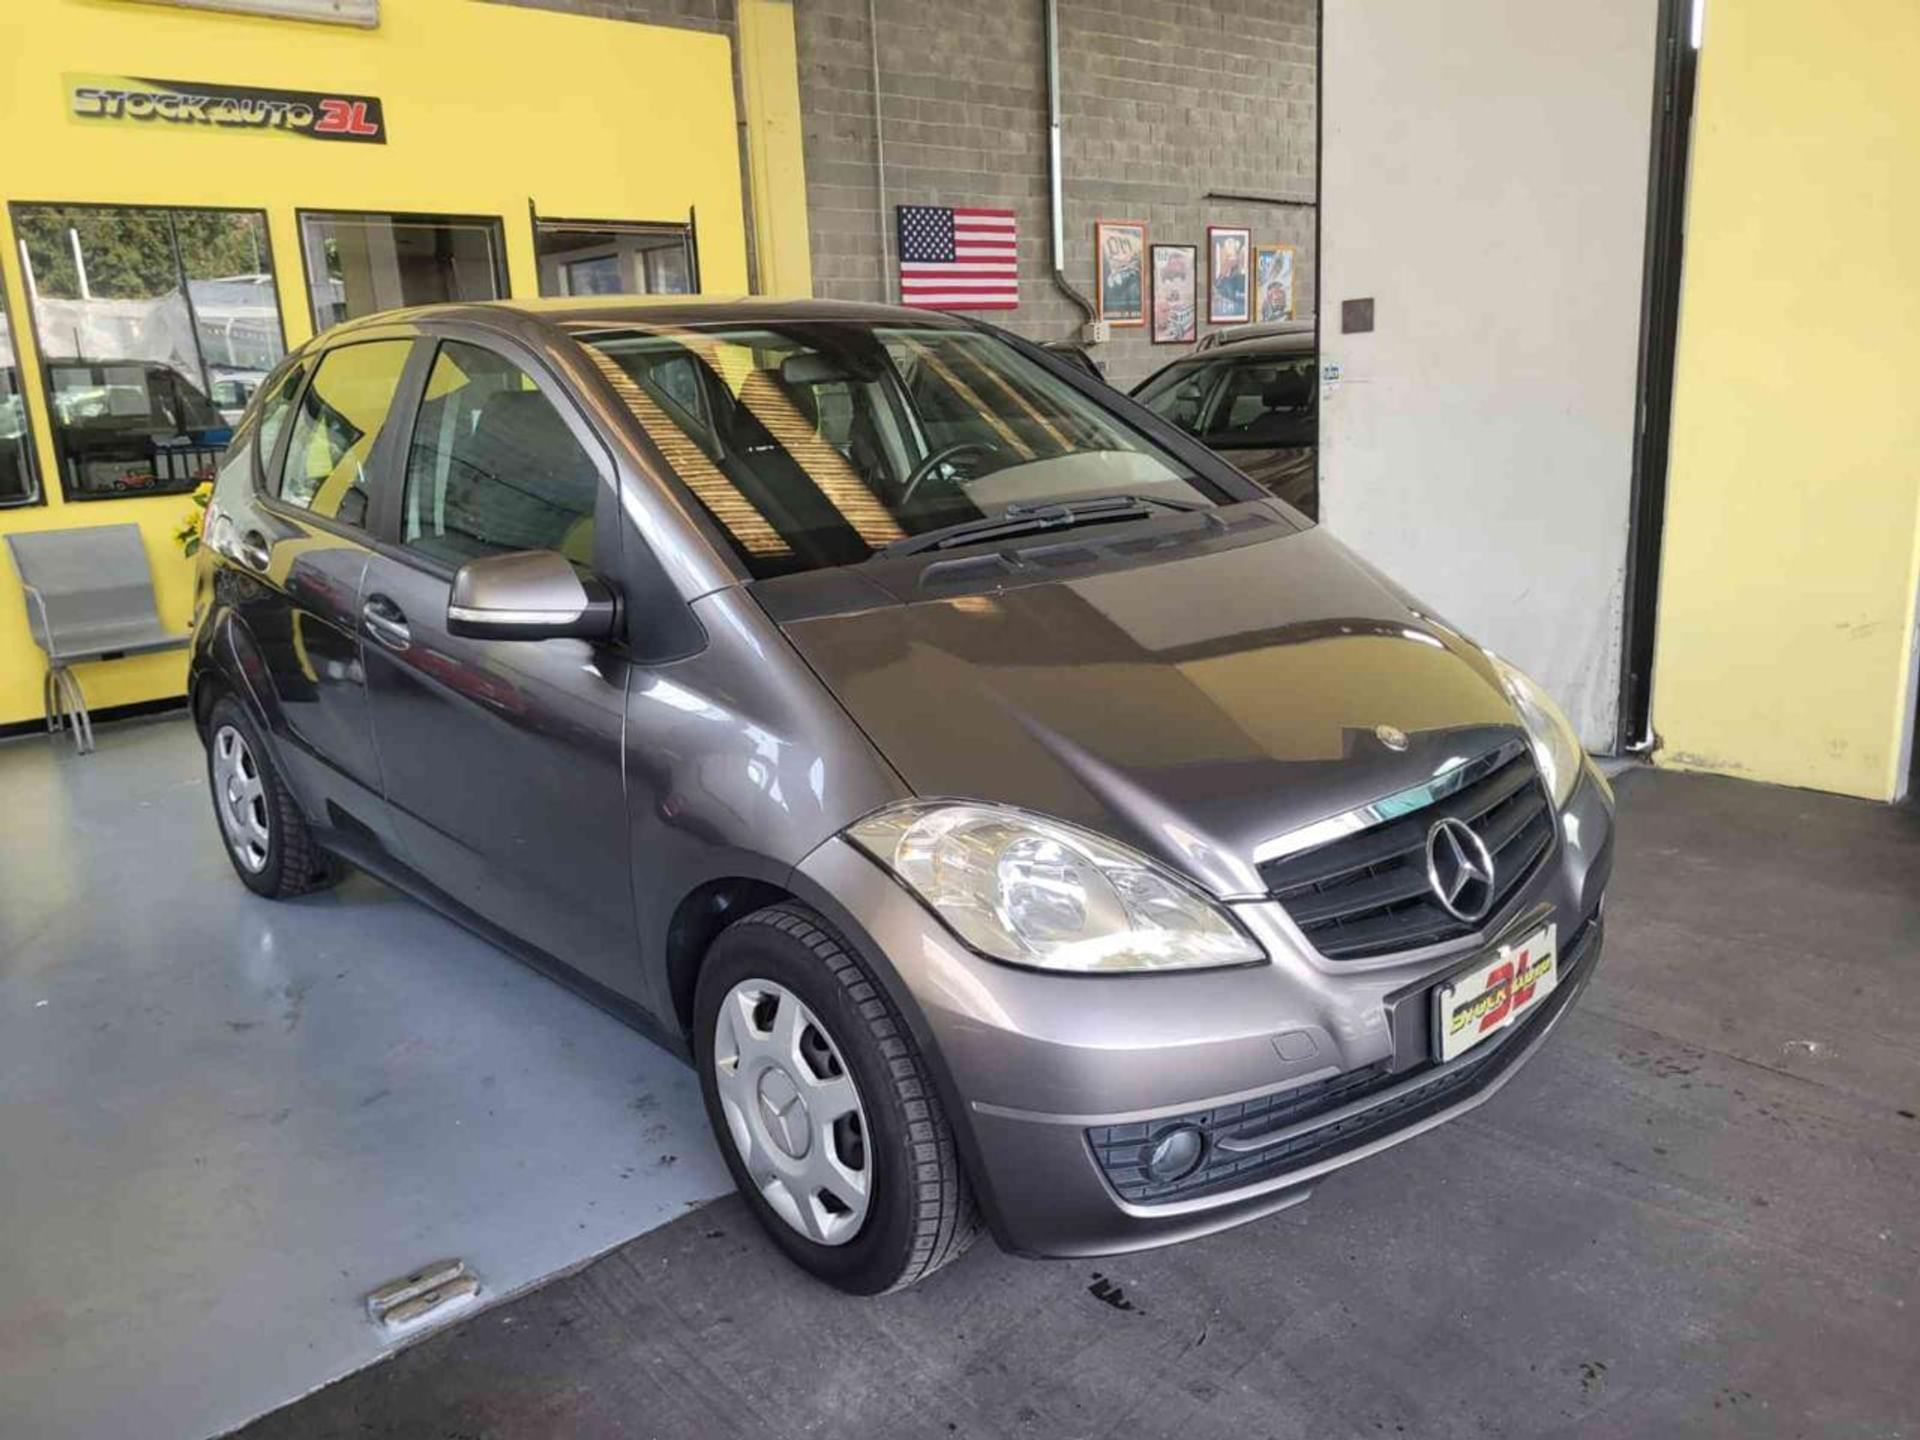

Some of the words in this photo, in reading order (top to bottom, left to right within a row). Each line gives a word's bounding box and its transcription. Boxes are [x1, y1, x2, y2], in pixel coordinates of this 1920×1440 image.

[75, 88, 208, 121] STOCK
[208, 98, 314, 128] AUTO
[314, 99, 379, 135] 3L
